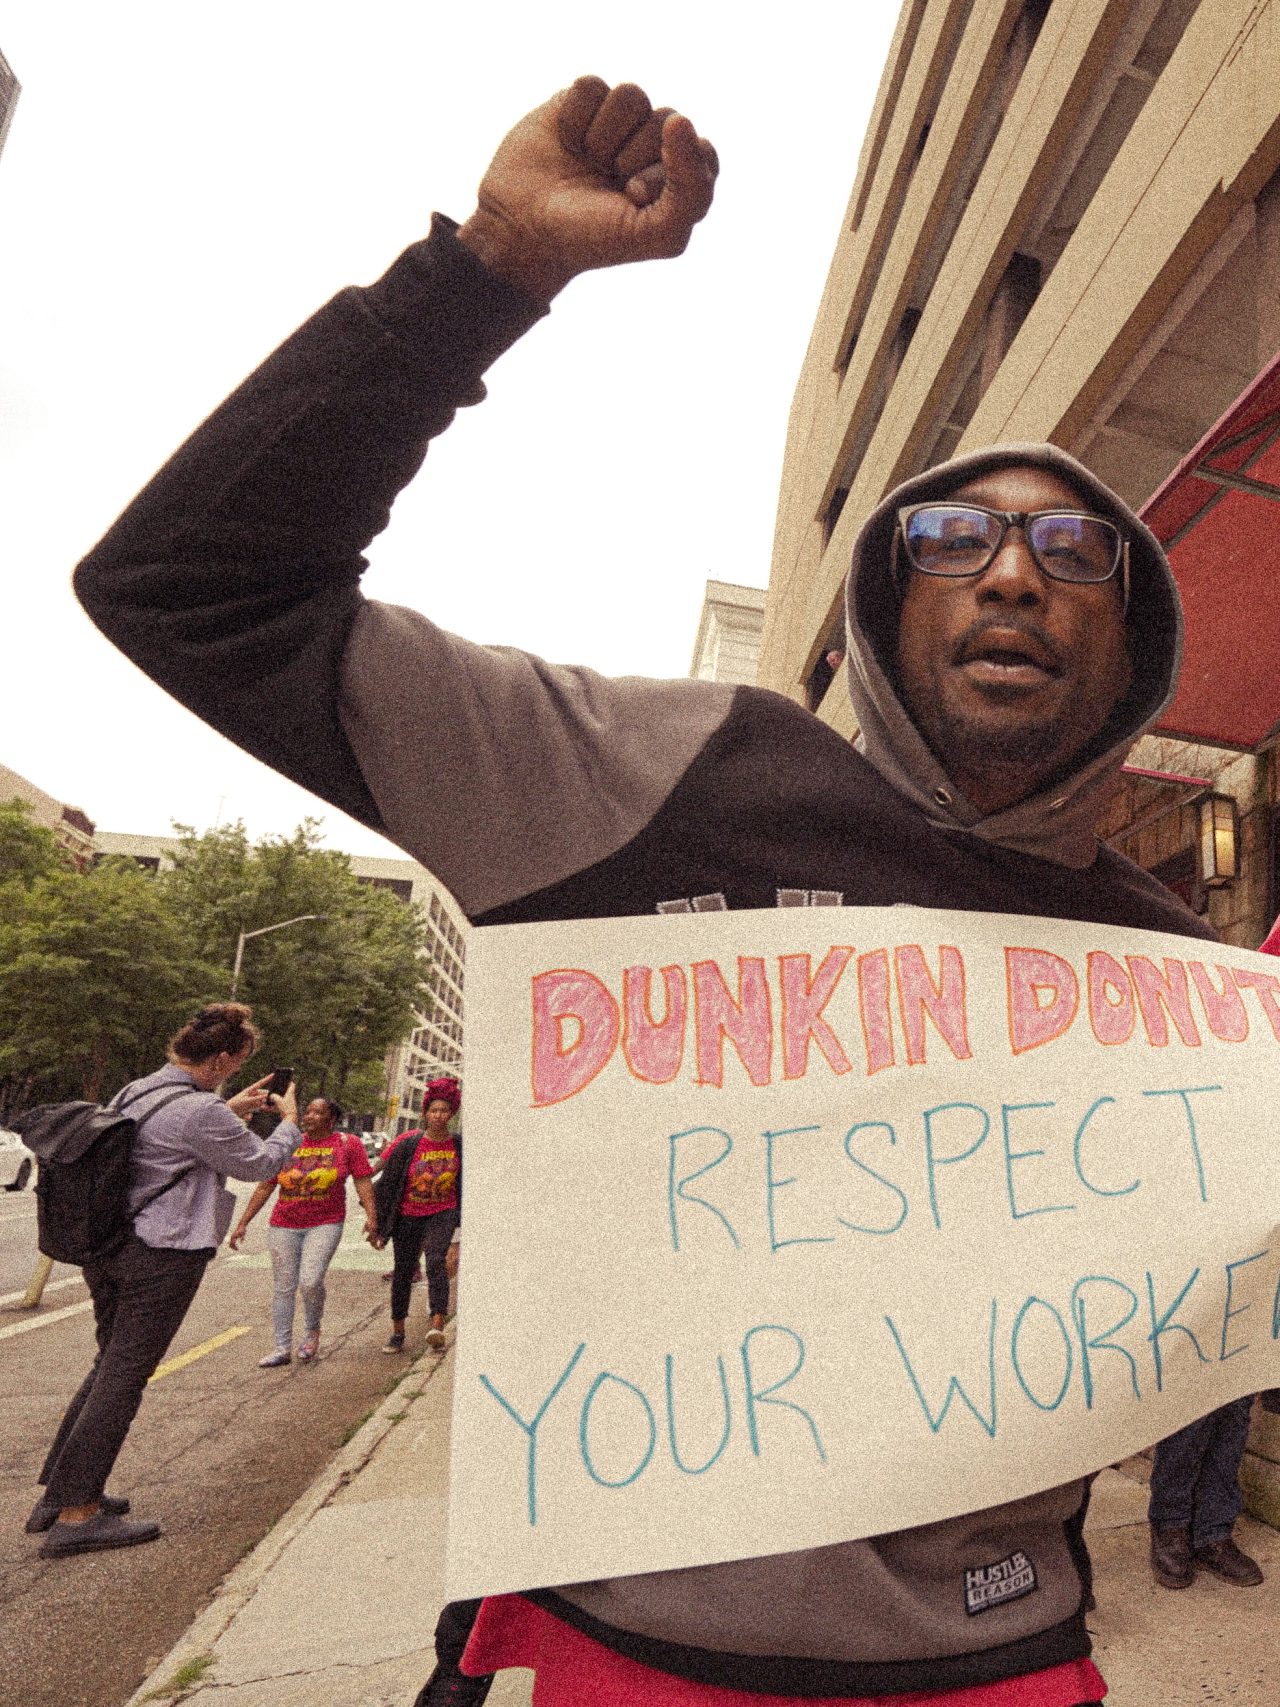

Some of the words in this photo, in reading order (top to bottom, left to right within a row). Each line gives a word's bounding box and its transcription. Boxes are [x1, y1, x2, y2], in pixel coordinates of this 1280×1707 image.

[530, 943, 972, 1108] DUNKIN
[668, 1086, 1222, 1252] RESPECT
[479, 1326, 828, 1526] YOUR
[972, 1572, 1031, 1601] REASON
